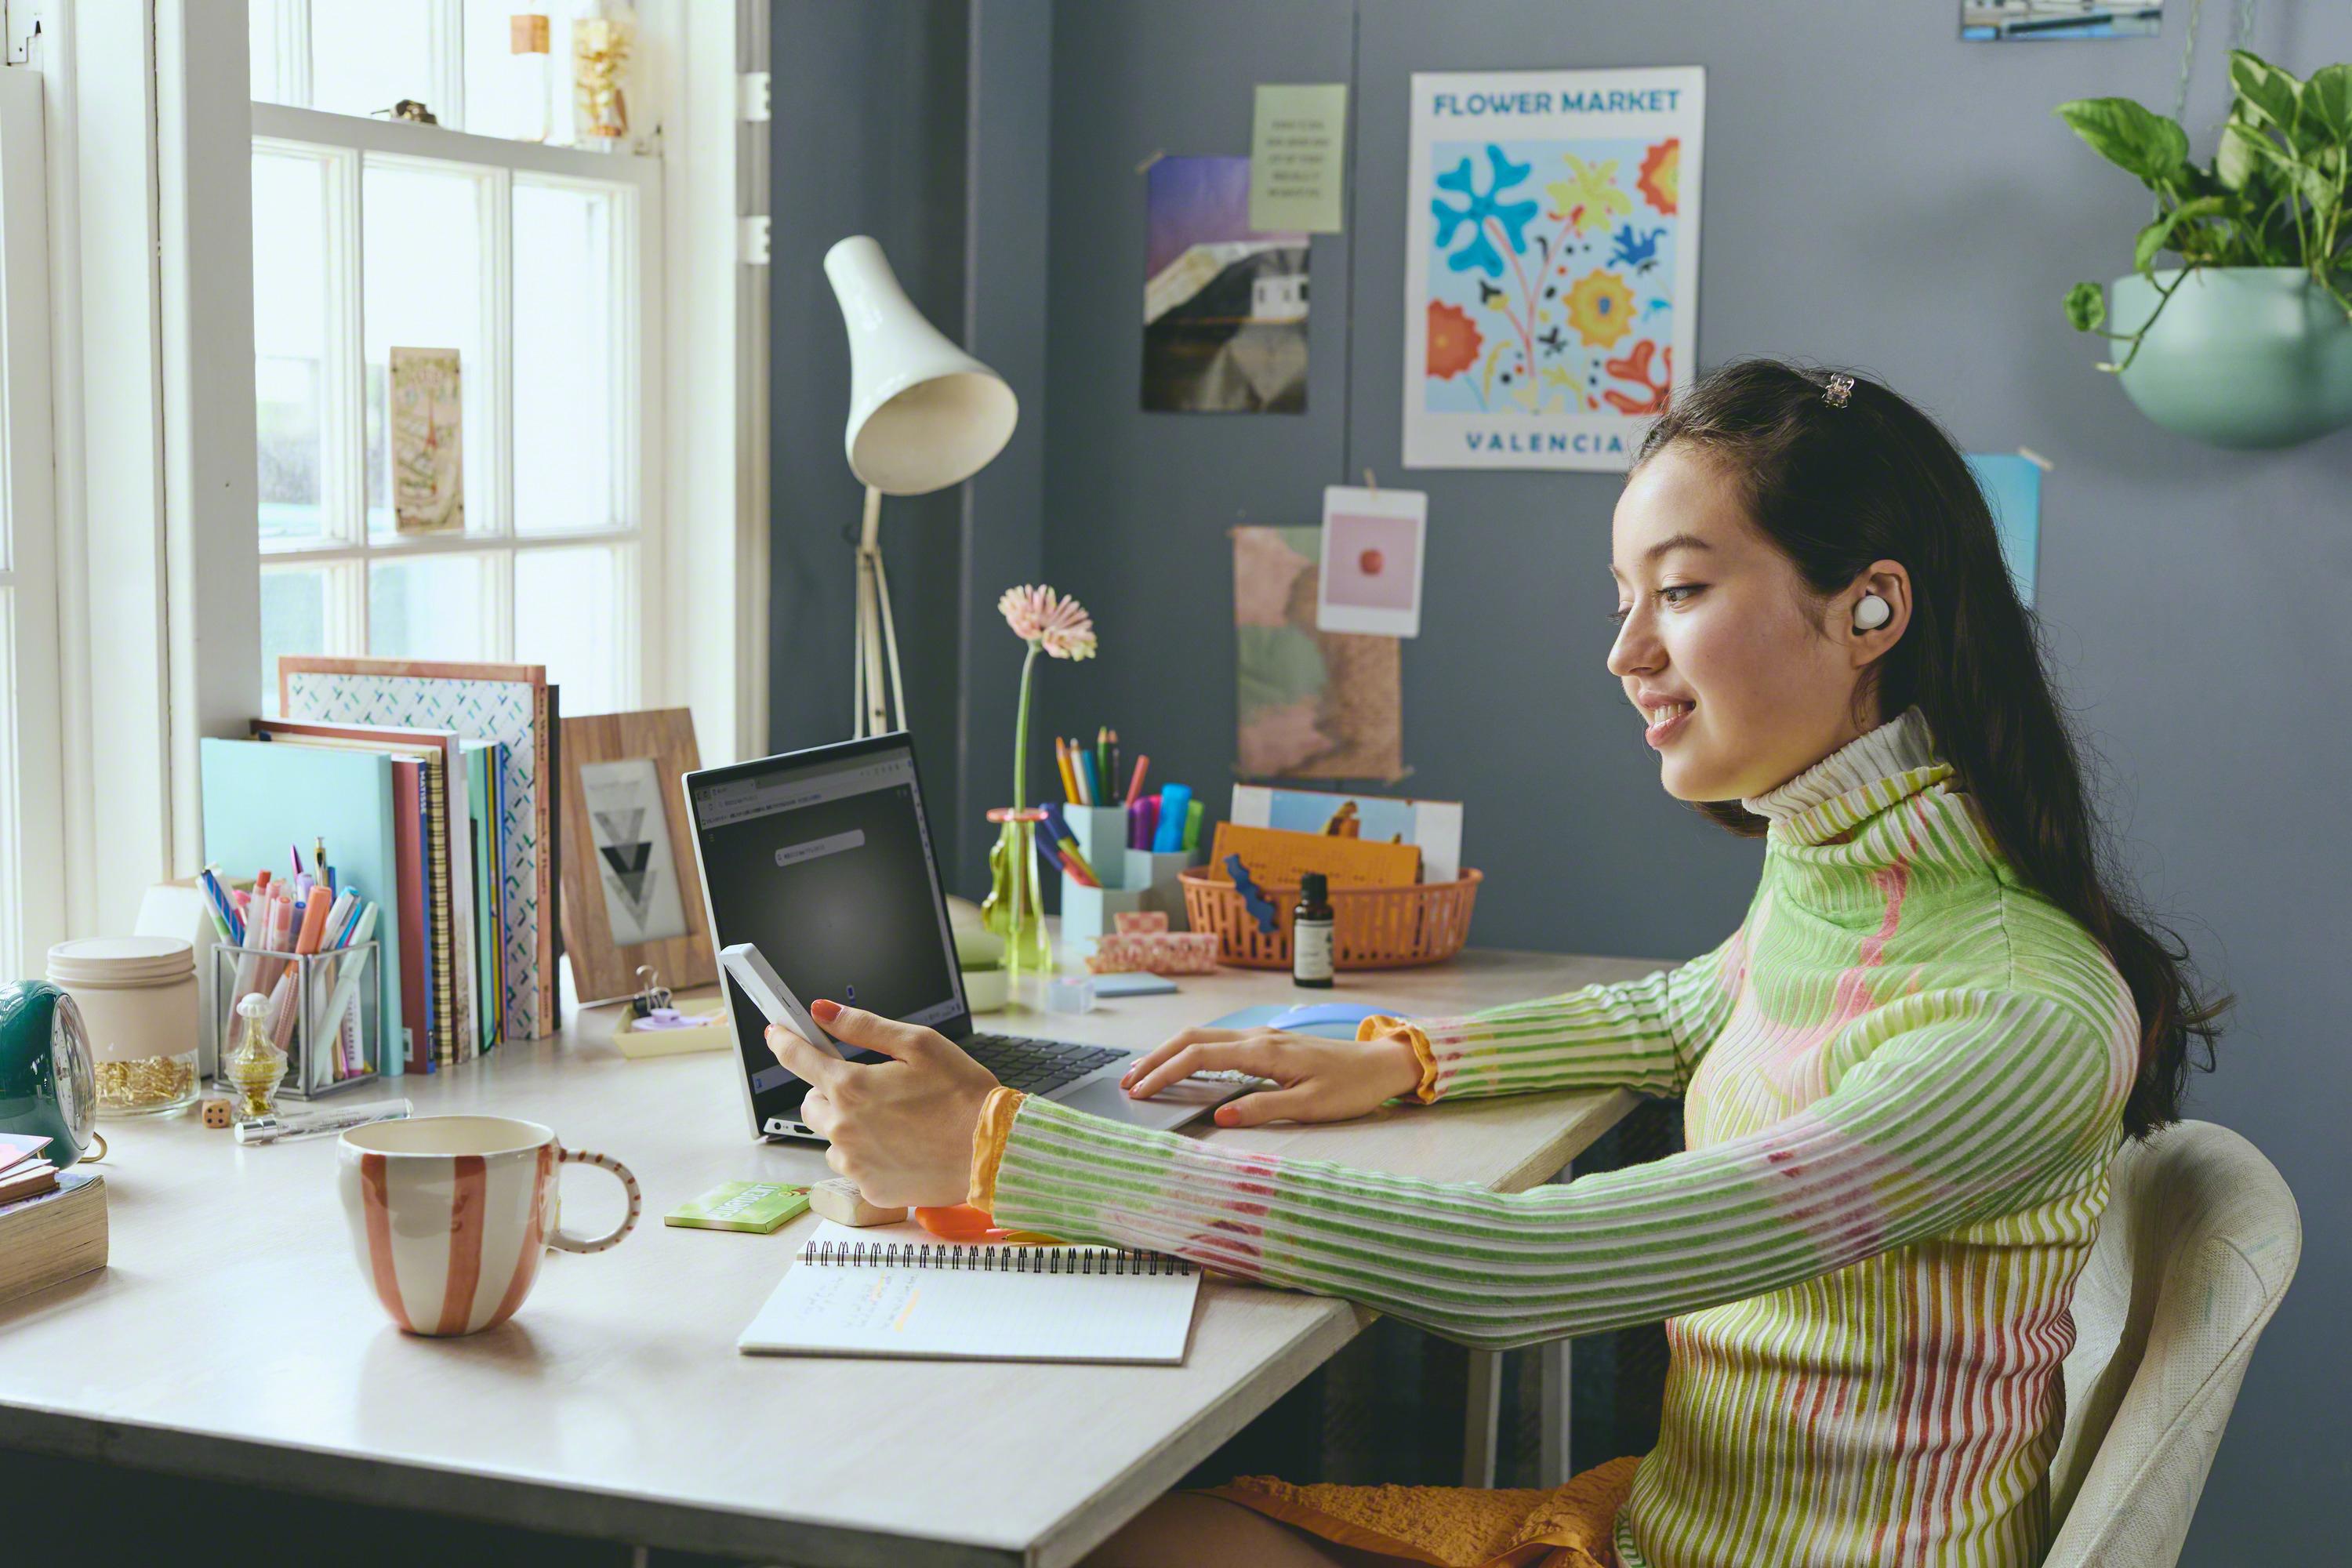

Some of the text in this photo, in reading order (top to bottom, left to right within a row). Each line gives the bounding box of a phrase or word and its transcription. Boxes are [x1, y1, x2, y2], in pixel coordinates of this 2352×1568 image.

[1432, 89, 1680, 115] FLOWER MARKET
[1466, 433, 1623, 452] VALENCIA
